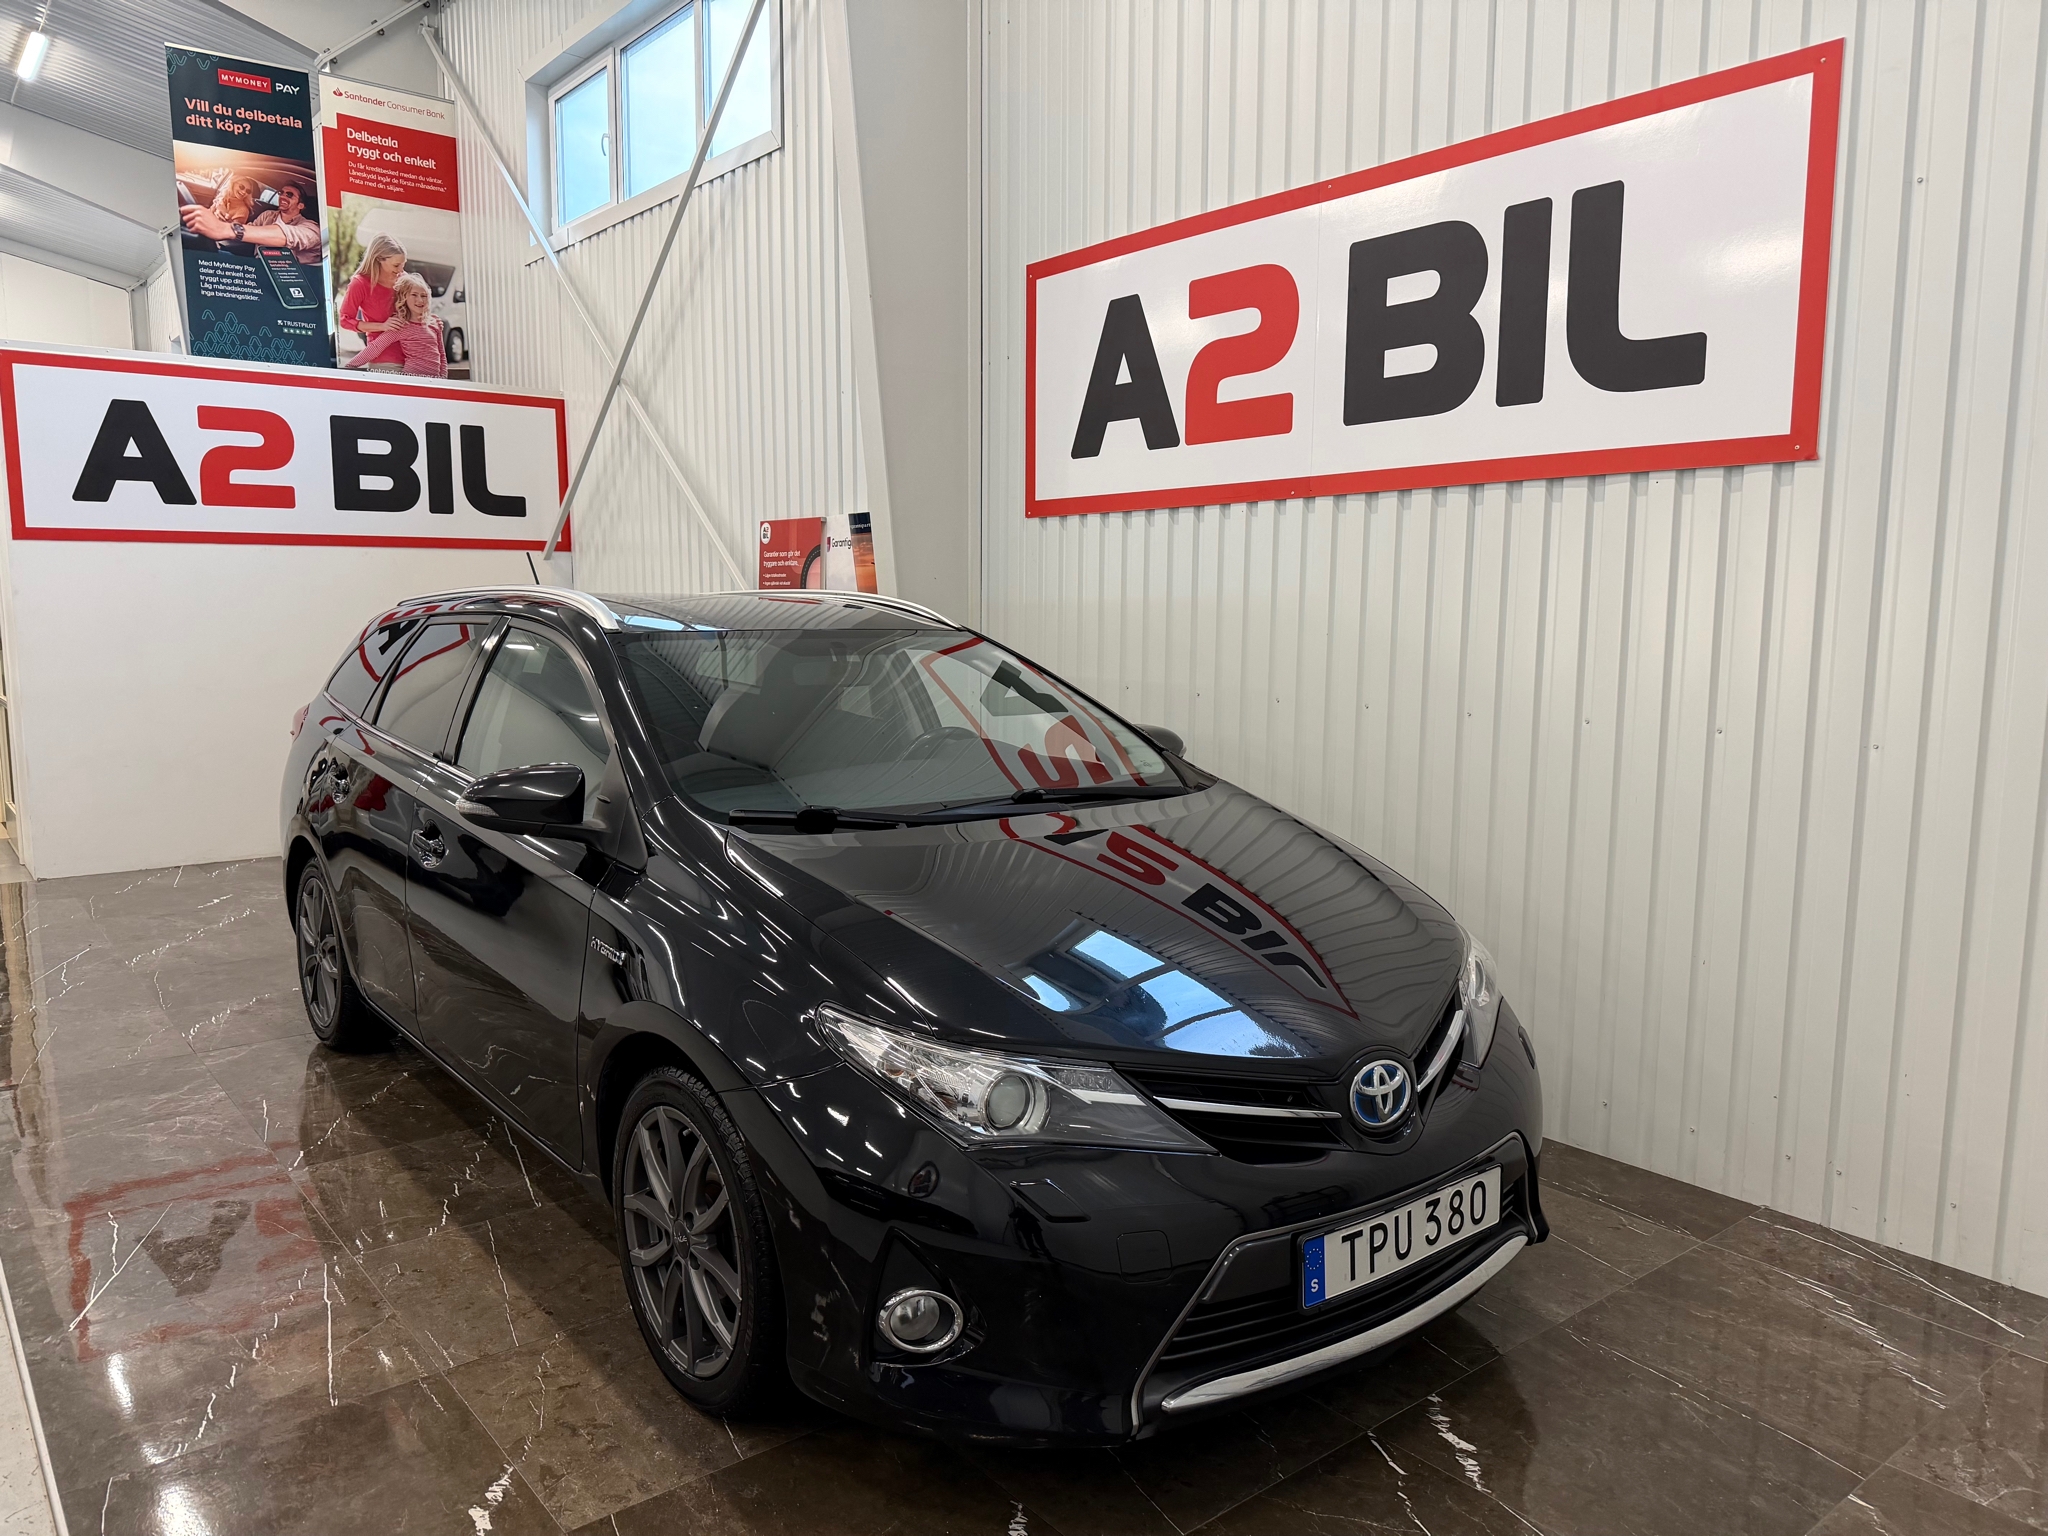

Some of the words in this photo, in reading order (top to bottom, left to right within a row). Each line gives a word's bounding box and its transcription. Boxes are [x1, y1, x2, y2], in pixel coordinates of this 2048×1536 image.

[221, 74, 268, 88] MYMONEY
[275, 82, 300, 95] PAY
[184, 97, 210, 112] Vill
[213, 103, 232, 116] du
[236, 107, 303, 129] delbetala
[344, 91, 386, 107] Santander
[386, 101, 426, 116] Consumer
[426, 109, 446, 120] Bank
[186, 114, 213, 128] ditt
[216, 118, 251, 135] köp?
[346, 127, 399, 148] Delbetala
[347, 142, 381, 160] tryggt
[383, 151, 402, 163] och
[404, 155, 437, 170] enkelt
[349, 177, 364, 185] Prata
[213, 261, 244, 271] MyMoney
[244, 265, 256, 273] Pay
[200, 275, 219, 283] tryggt
[283, 320, 317, 329] TRUSTPILOT
[1070, 263, 1300, 460] A2
[1343, 180, 1708, 426] BIL
[72, 398, 296, 509] A2
[329, 414, 527, 518] BIL
[1341, 1209, 1412, 1282] TPU
[1424, 1180, 1487, 1246] 380
[1311, 1278, 1319, 1292] S
